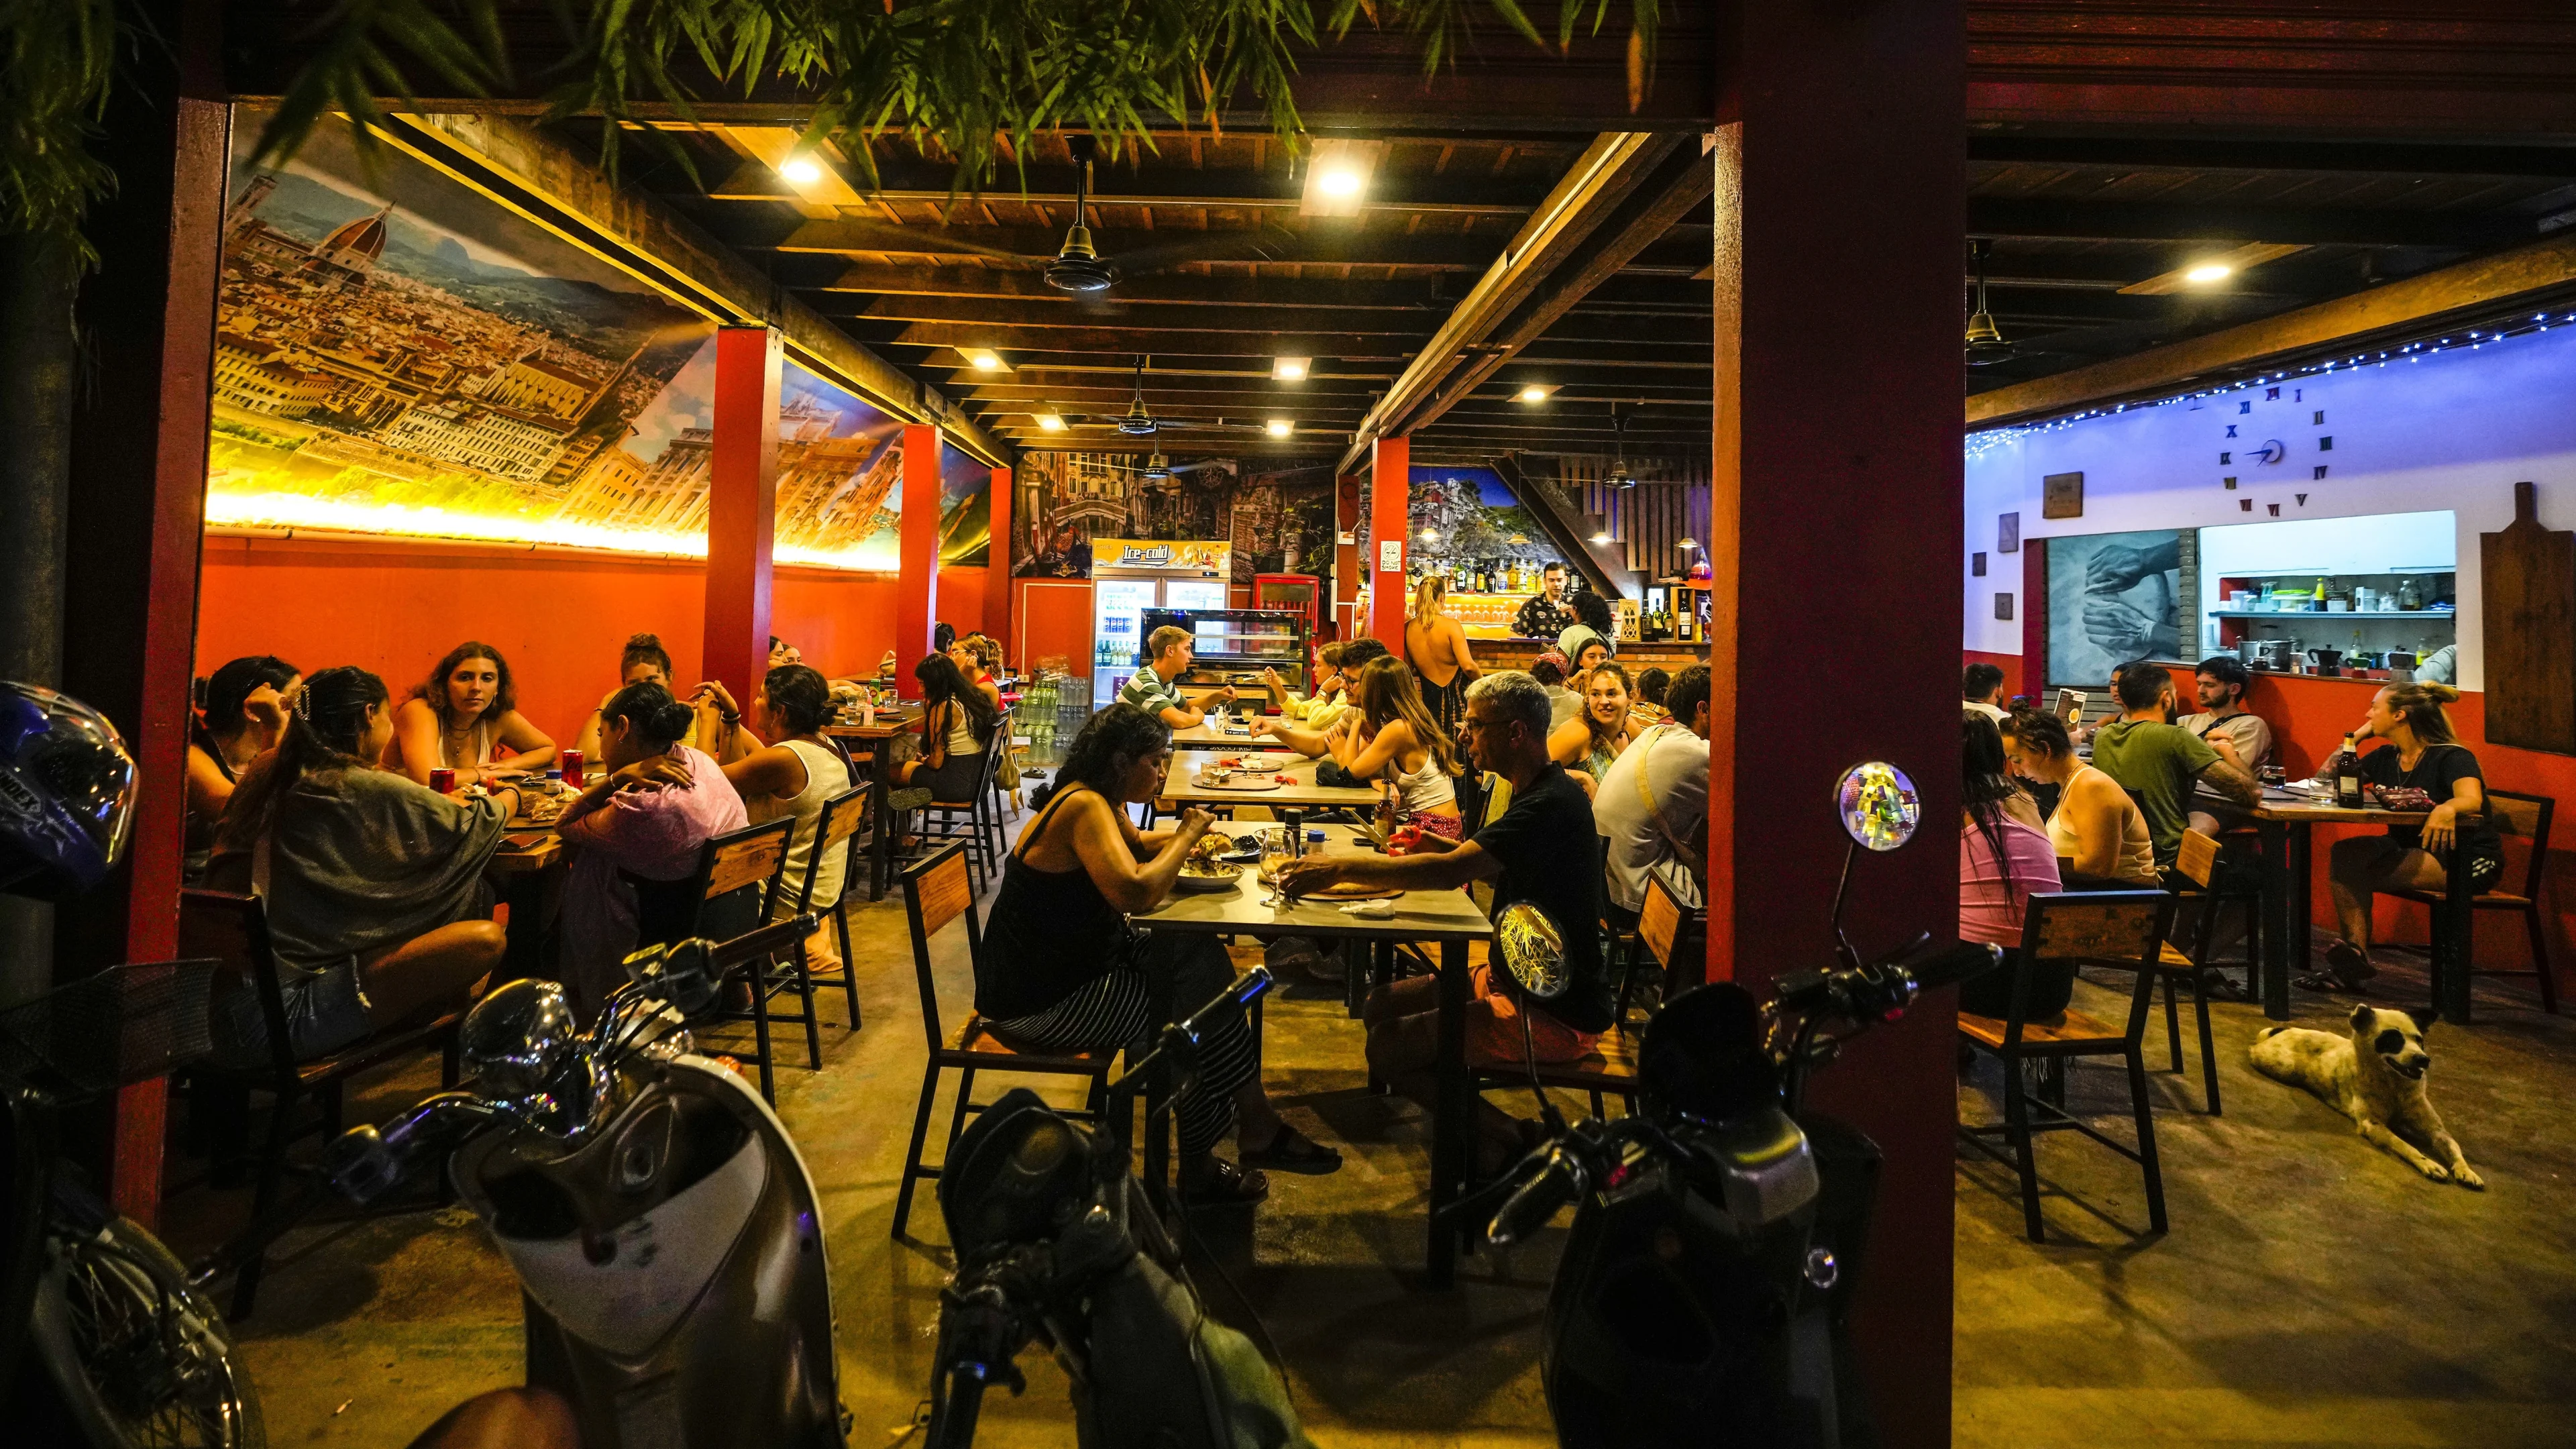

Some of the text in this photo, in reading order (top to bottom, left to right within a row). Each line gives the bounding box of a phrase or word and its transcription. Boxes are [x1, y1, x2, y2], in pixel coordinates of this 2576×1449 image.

[2313, 410, 2324, 425] II
[2226, 425, 2238, 438] X
[2319, 436, 2332, 451] III
[2313, 465, 2328, 480] IV
[2294, 494, 2308, 506] V
[2267, 503, 2280, 517] VI
[1122, 544, 1169, 560] Ice-cold
